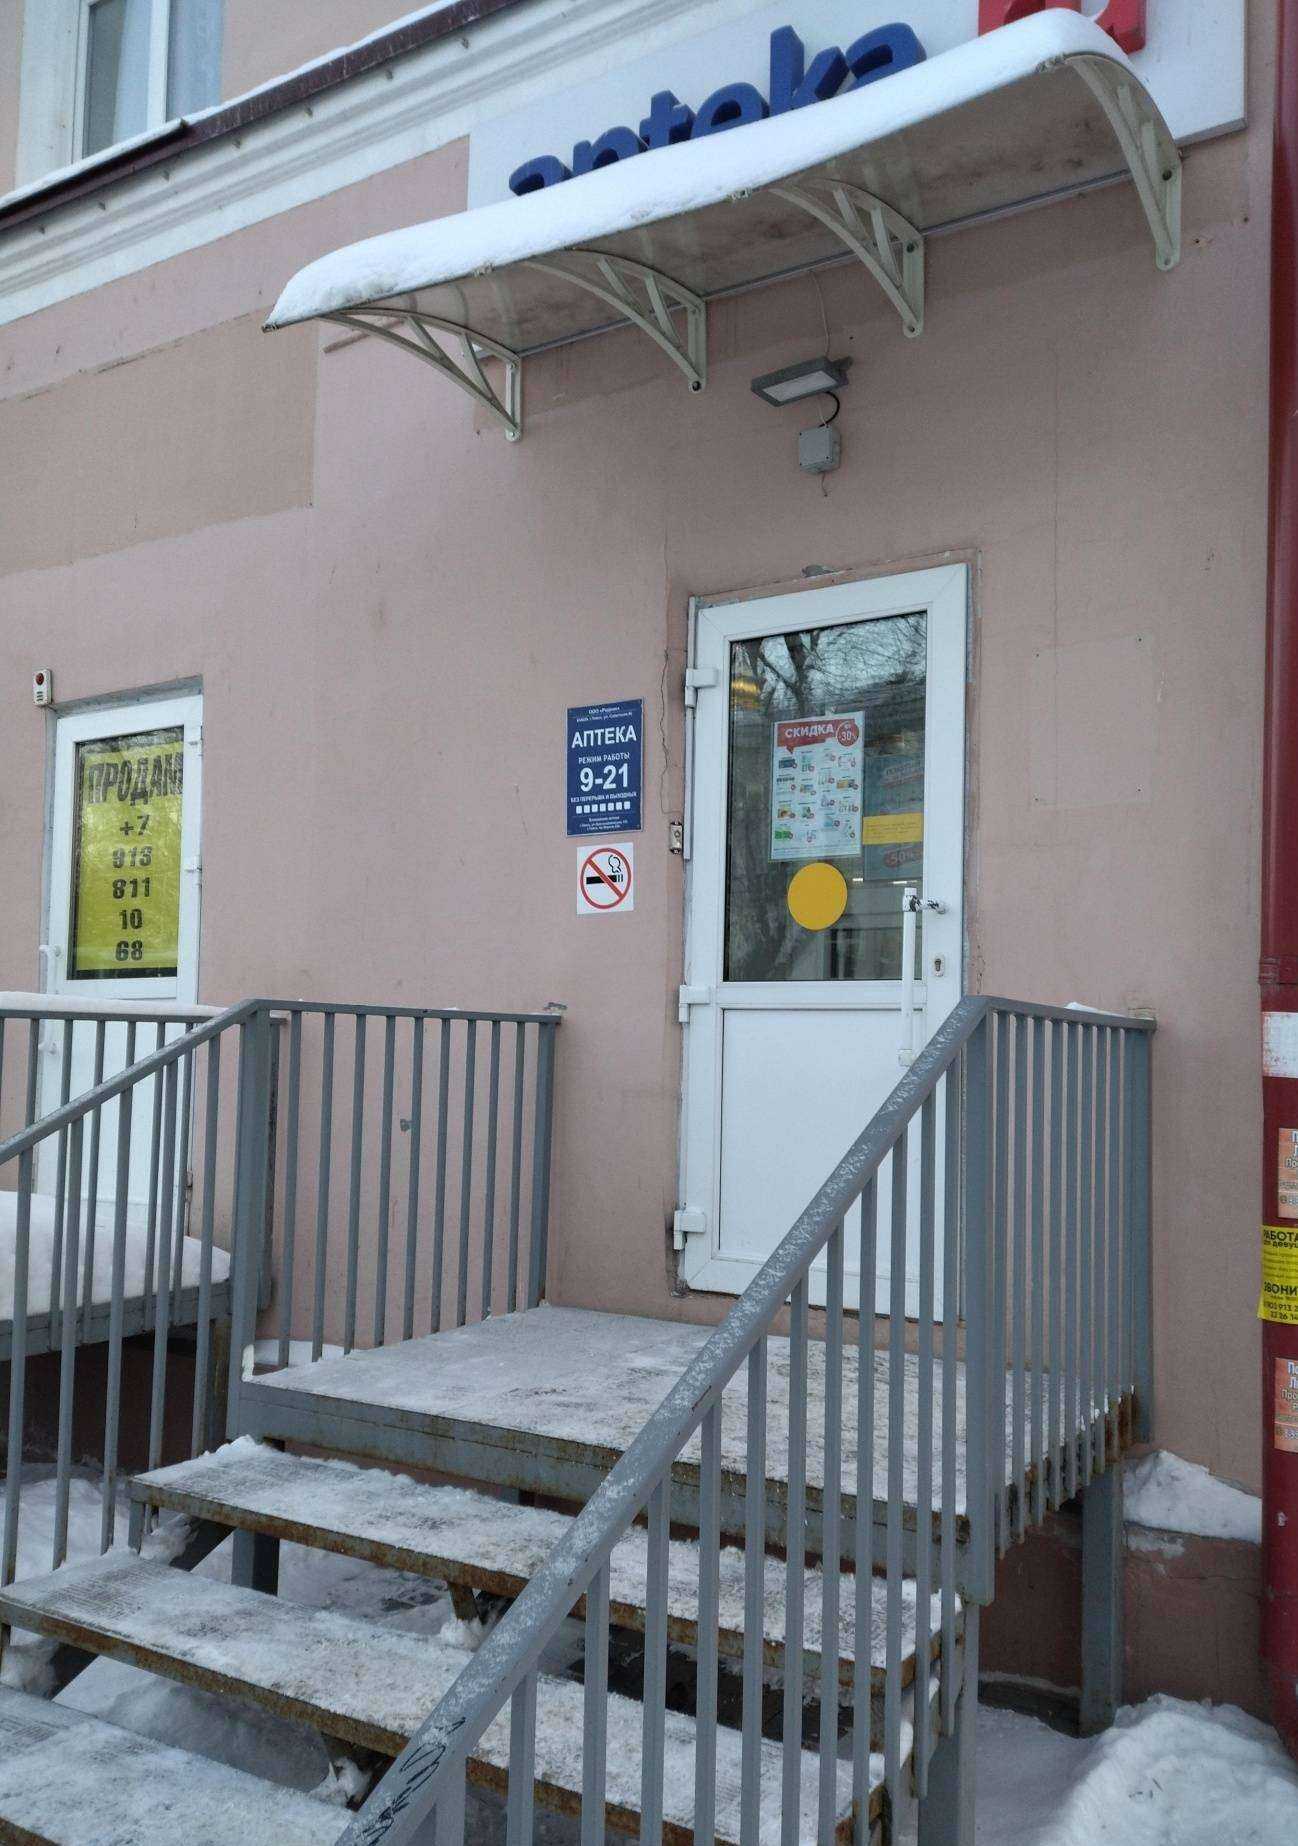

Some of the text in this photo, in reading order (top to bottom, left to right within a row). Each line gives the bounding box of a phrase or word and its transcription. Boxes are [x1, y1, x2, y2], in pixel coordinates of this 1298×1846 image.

[571, 725, 637, 748] АПТЕКА
[785, 724, 834, 738] СКИДКА
[578, 752, 630, 764] РЕЖИМ РАБОТЫ
[580, 763, 628, 792] 9-21
[120, 814, 149, 836] +7
[112, 846, 152, 869] 913
[112, 877, 150, 899] 811
[119, 908, 143, 930] 10
[115, 940, 143, 961] 68
